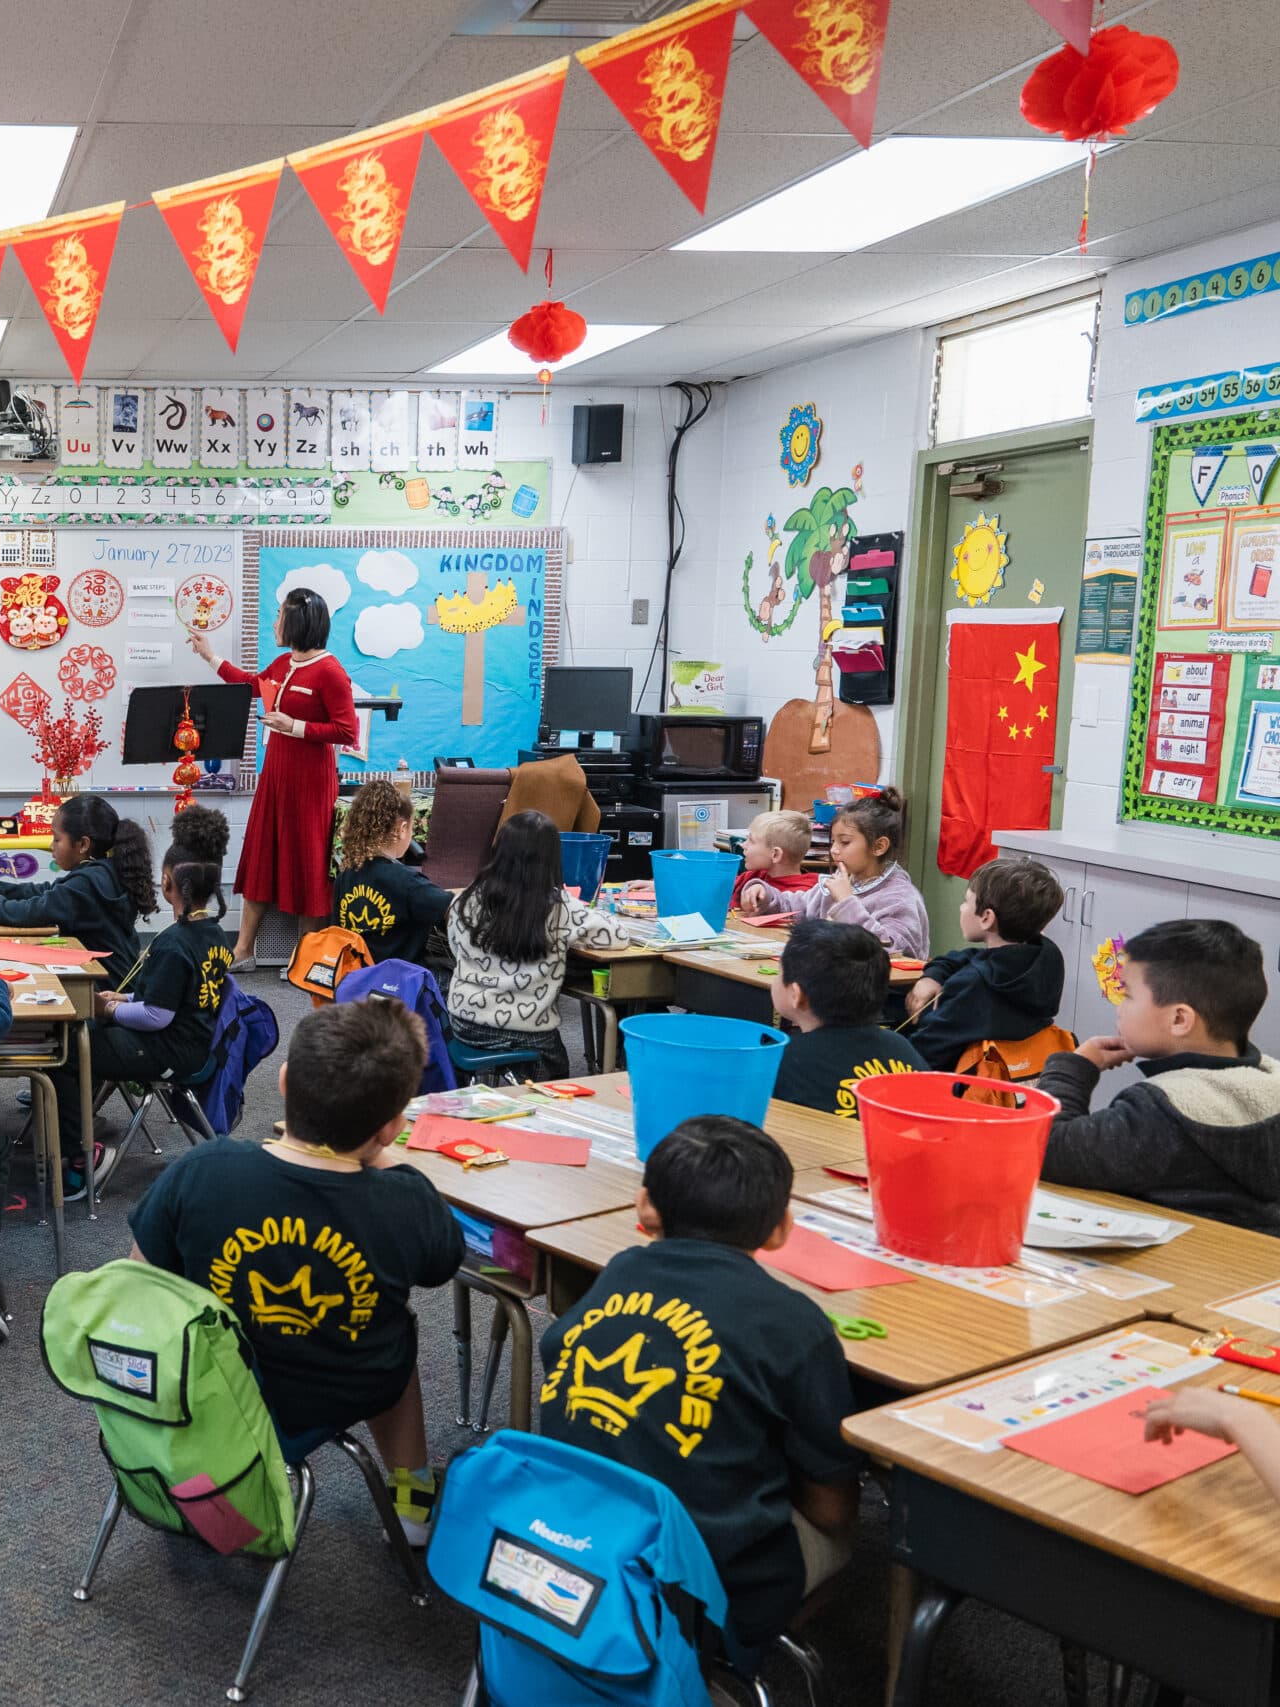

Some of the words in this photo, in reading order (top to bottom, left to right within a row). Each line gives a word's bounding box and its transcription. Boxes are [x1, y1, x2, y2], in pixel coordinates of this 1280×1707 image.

[1131, 302, 1137, 316] 0
[1151, 299, 1154, 312] 1
[1170, 292, 1176, 307] 2
[1190, 287, 1197, 301] 3
[1211, 281, 1219, 294] 4
[1234, 275, 1242, 290] 5
[1257, 269, 1264, 284] 6
[1200, 386, 1215, 402] 54
[1223, 382, 1238, 399] 55
[1245, 380, 1260, 395] 56
[67, 439, 91, 453] Uu
[112, 439, 135, 453] Vv
[156, 439, 188, 453] Ww
[207, 439, 230, 453] Xx
[254, 439, 277, 456] Yy
[296, 439, 317, 454] Zz
[340, 440, 360, 456] sh
[379, 441, 400, 456] ch
[427, 442, 446, 456] th
[464, 441, 489, 456] wh
[0, 488, 19, 512] Yy
[31, 488, 51, 504] Zz
[70, 487, 81, 504] 0
[95, 488, 99, 504] 1
[116, 488, 126, 504] 2
[141, 488, 151, 504] 3
[166, 488, 176, 504] 4
[191, 488, 201, 504] 5
[216, 488, 226, 504] 6
[288, 489, 296, 505] 9
[310, 489, 325, 505] 10
[1220, 492, 1244, 501] Phonics
[93, 539, 159, 568] January
[166, 543, 191, 564] 27
[193, 544, 233, 563] 2023
[440, 553, 543, 573] KINGDOM
[84, 575, 106, 596] 福
[183, 582, 225, 597] 平安喜乐
[1248, 639, 1267, 647] Words
[1186, 664, 1208, 676] about
[704, 673, 725, 683] Dear
[1187, 692, 1201, 702] our
[1180, 717, 1205, 729] animal
[1179, 743, 1199, 755] eight
[1173, 776, 1196, 789] carry
[340, 884, 365, 928] INGDOM
[835, 1058, 888, 1119] NGDOM
[211, 1216, 306, 1304] KINGDOM
[314, 1226, 379, 1342] MINDSET
[127, 1357, 148, 1369] Slide
[540, 1292, 653, 1403] KINGDOM
[654, 1298, 723, 1458] MINDSET
